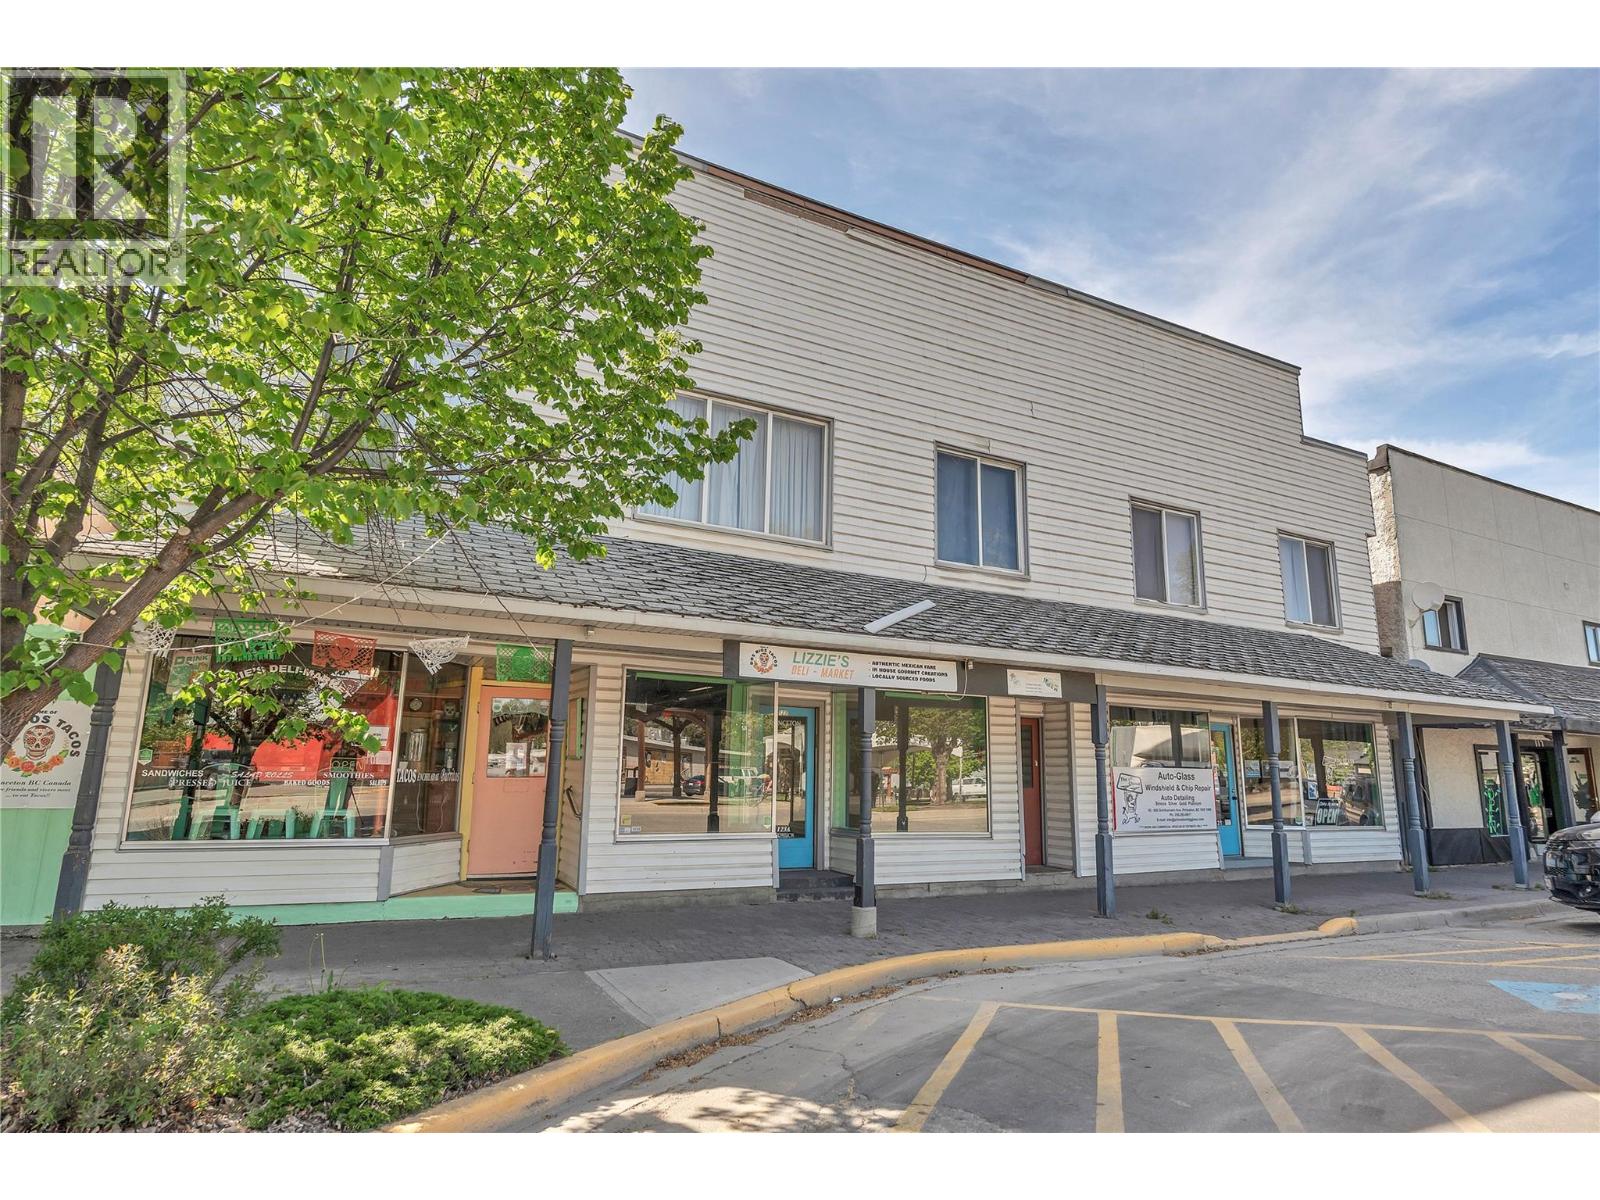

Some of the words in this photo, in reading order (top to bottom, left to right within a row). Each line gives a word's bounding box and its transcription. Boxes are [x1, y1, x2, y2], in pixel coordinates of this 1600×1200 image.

[792, 651, 850, 668] LIZZIE'S
[791, 665, 810, 676] DELI
[820, 668, 856, 680] MARKET
[56, 718, 82, 758] TACOS
[331, 759, 367, 772] OPEN
[140, 769, 204, 778] SANDWICHES
[322, 771, 375, 779] SMOOTHIES
[396, 768, 417, 783] TACOS
[1158, 772, 1196, 781] Auto-Glass
[172, 779, 217, 787] PRESSED
[222, 779, 253, 787] JUICE
[284, 779, 306, 787] BAKED
[307, 779, 331, 787] GOODS
[1145, 784, 1175, 792] Windshield
[1181, 784, 1194, 793] Chip
[1195, 784, 1212, 793] Repair
[1174, 795, 1195, 803] Detailing
[1316, 808, 1340, 824] OPEN
